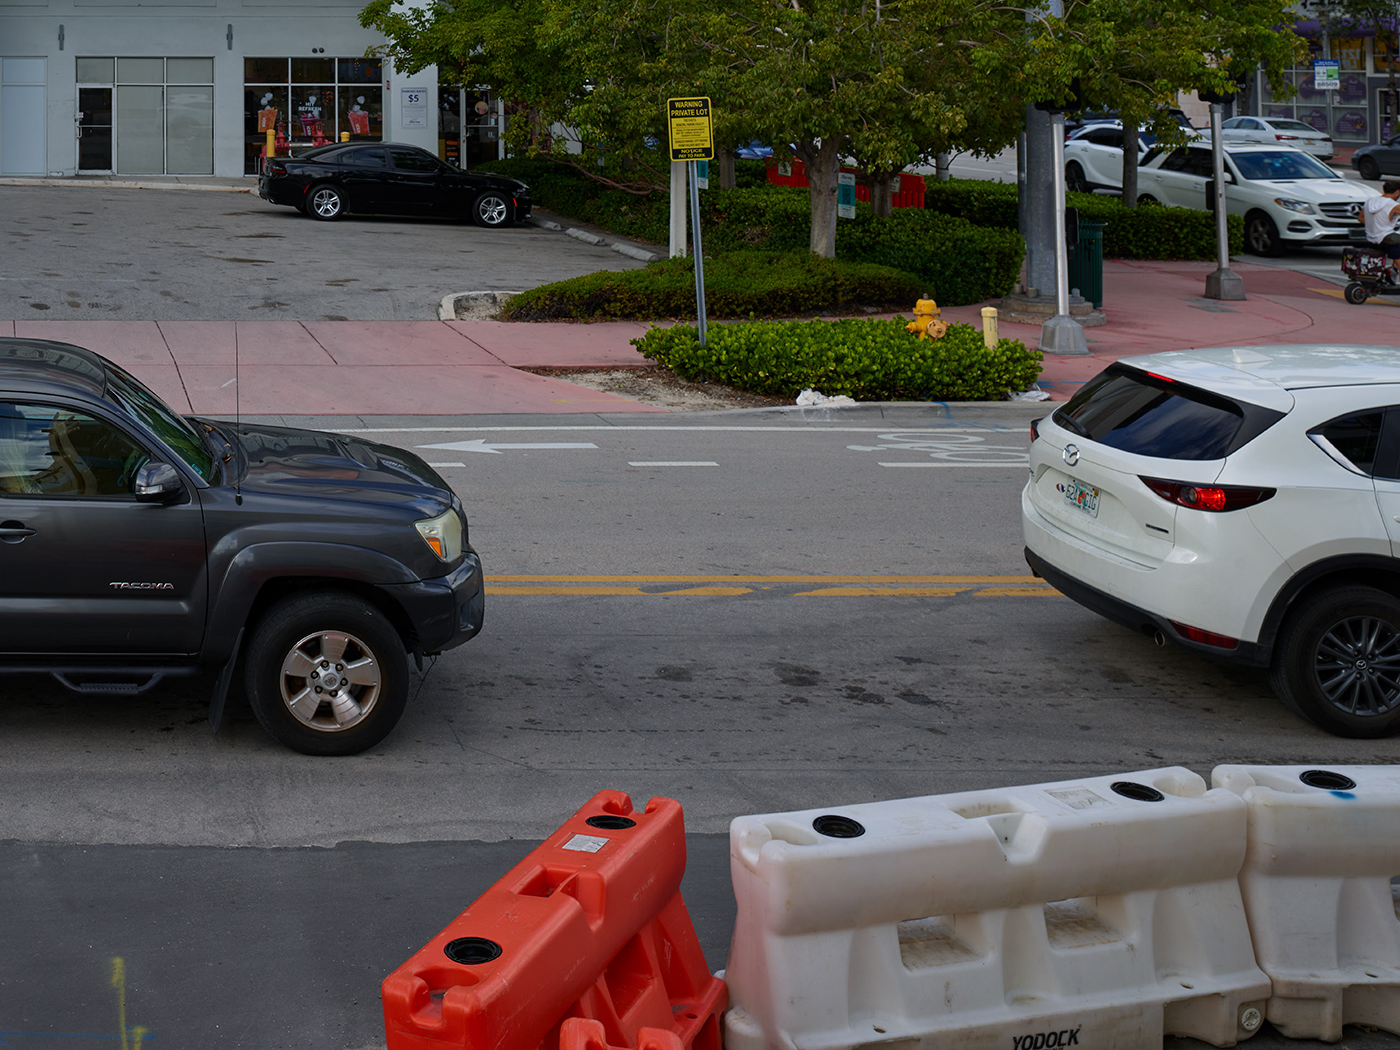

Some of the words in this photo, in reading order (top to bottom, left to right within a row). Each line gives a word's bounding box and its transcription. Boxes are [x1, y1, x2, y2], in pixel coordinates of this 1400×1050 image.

[408, 93, 420, 103] $5
[671, 109, 695, 117] PRIVATE
[109, 582, 174, 590] TACOMA
[1012, 1028, 1082, 1050] YODOCK
